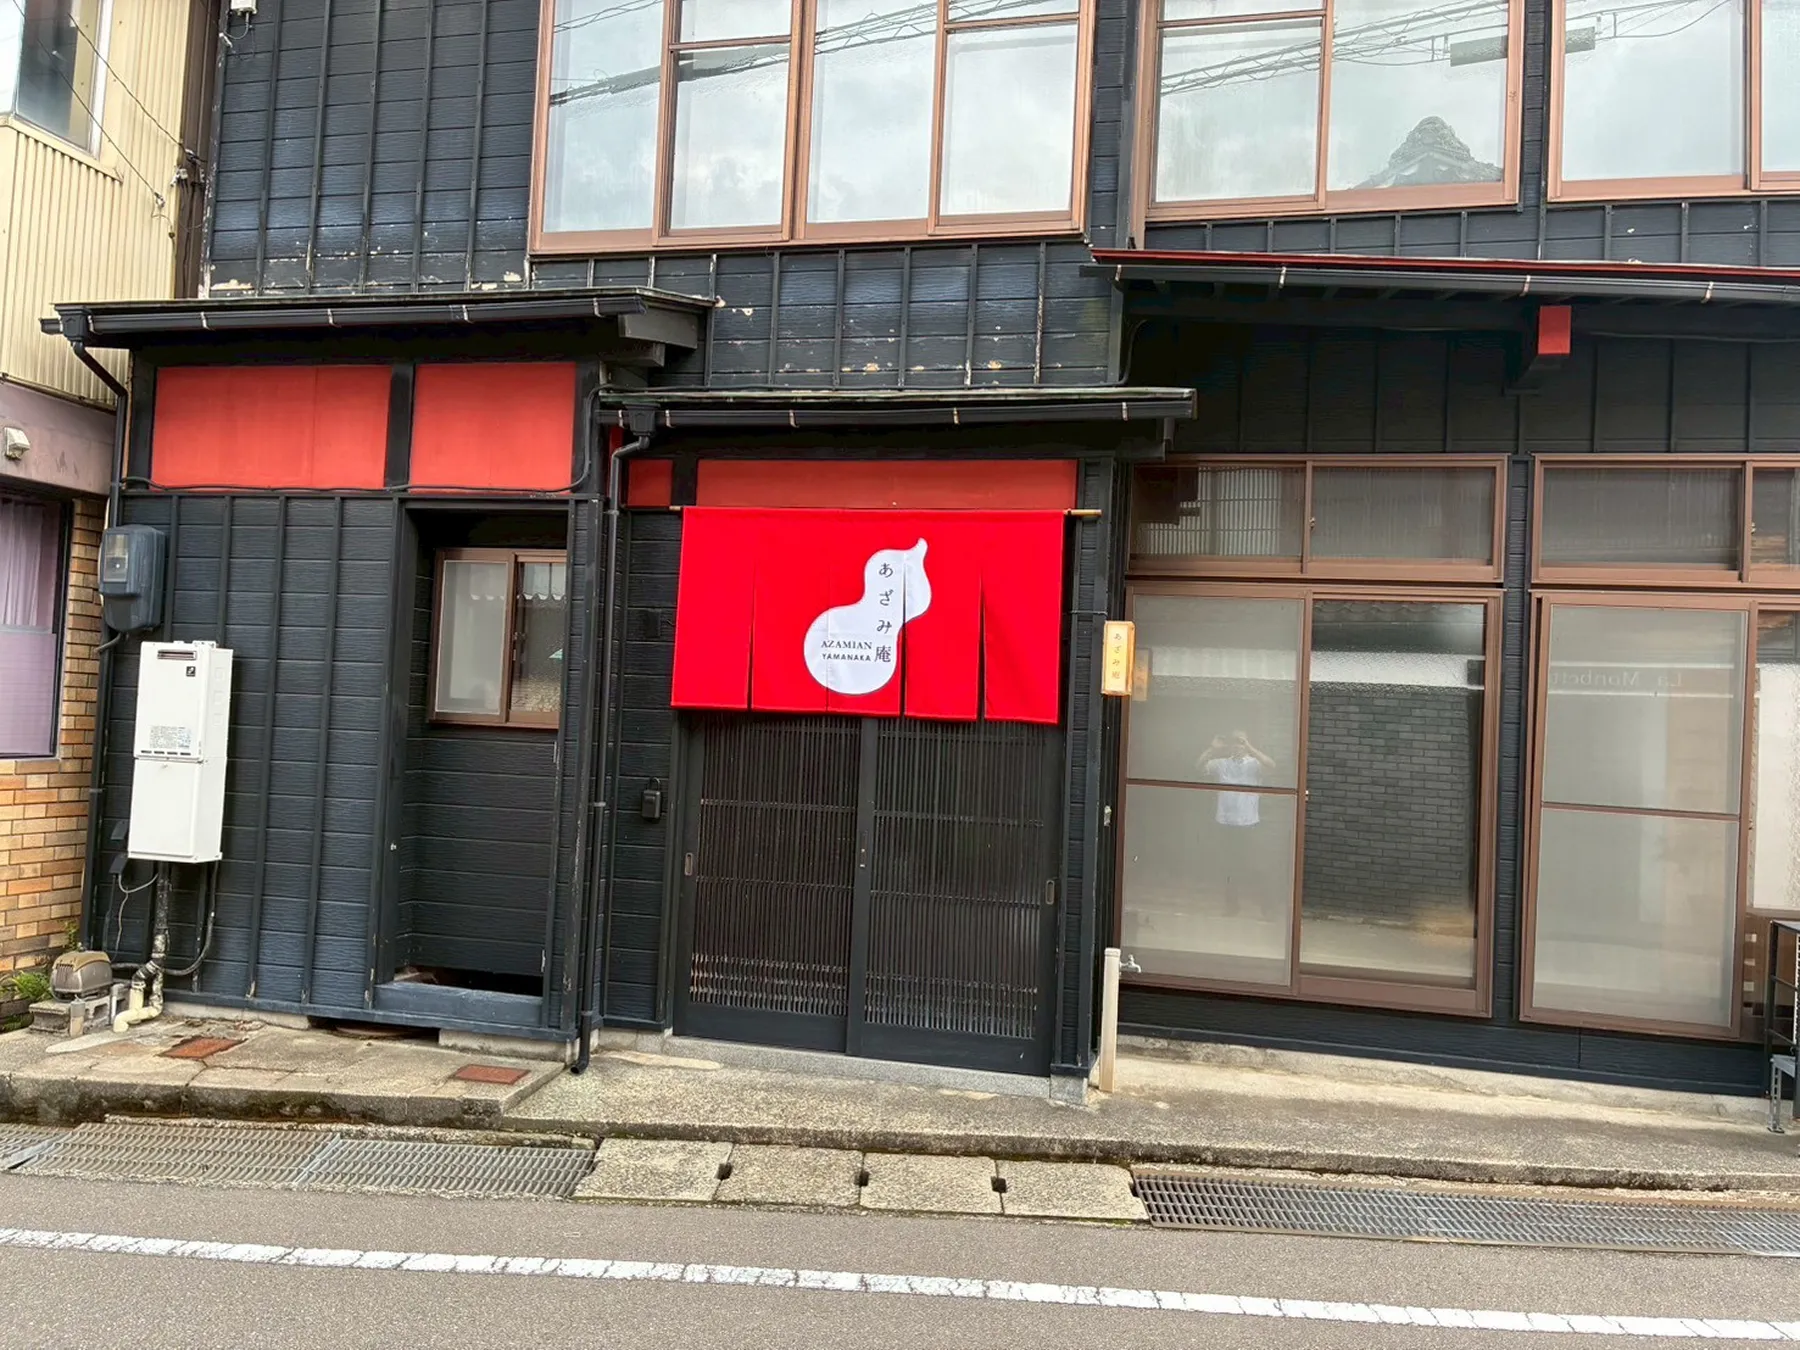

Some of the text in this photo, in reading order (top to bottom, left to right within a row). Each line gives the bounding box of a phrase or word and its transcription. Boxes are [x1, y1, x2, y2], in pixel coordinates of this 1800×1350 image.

[874, 562, 894, 663] あざみ庵
[821, 640, 873, 650] AZAMIAN
[822, 653, 872, 661] YAMANAKA
